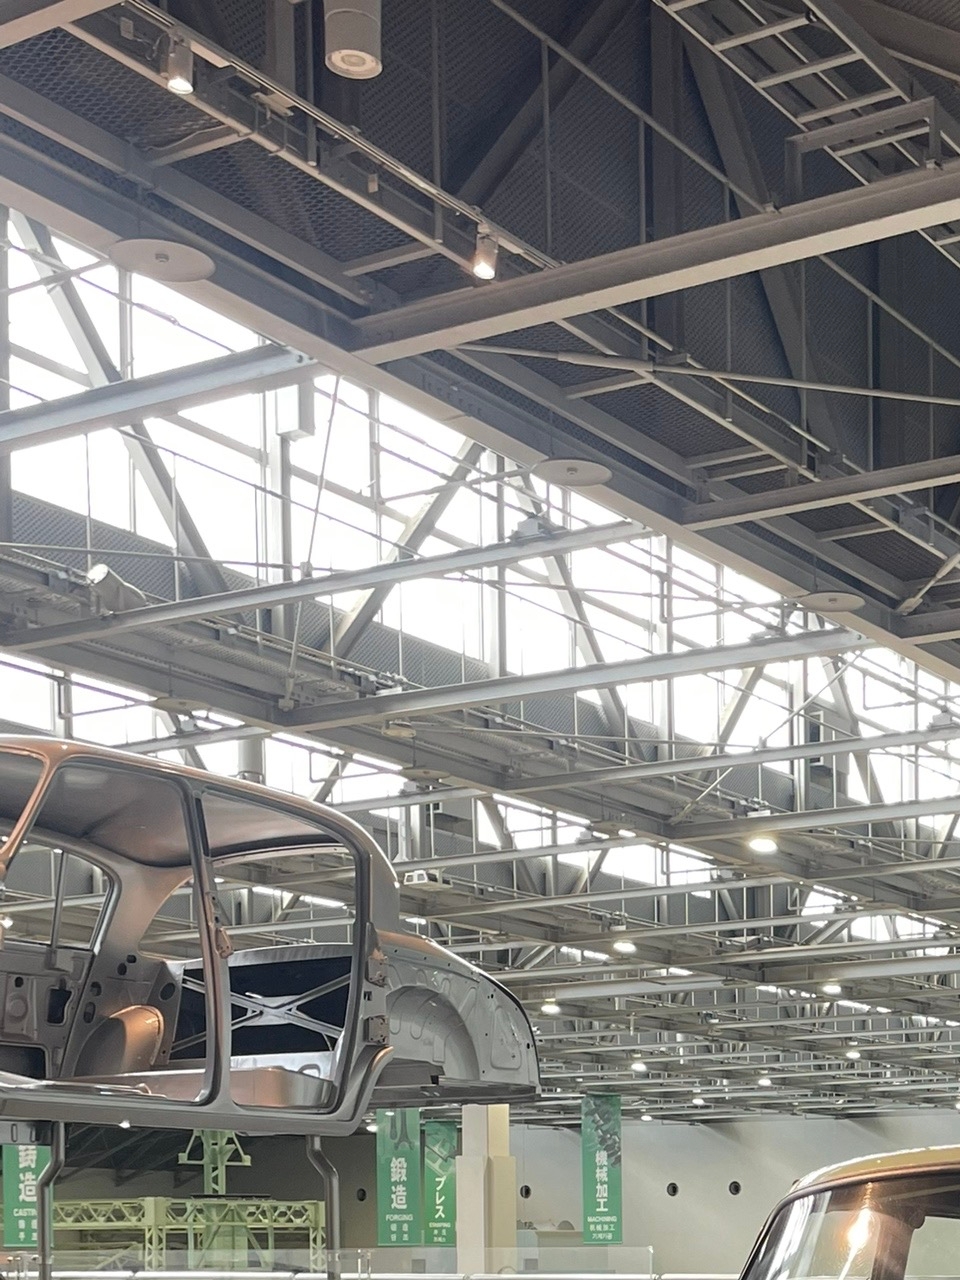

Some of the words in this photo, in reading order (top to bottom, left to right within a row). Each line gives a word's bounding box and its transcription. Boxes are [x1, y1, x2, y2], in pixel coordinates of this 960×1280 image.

[390, 1156, 407, 1210] 鍛造
[434, 1175, 447, 1219] プレス
[595, 1150, 608, 1212] 機械加工
[385, 1214, 413, 1222] FORGING
